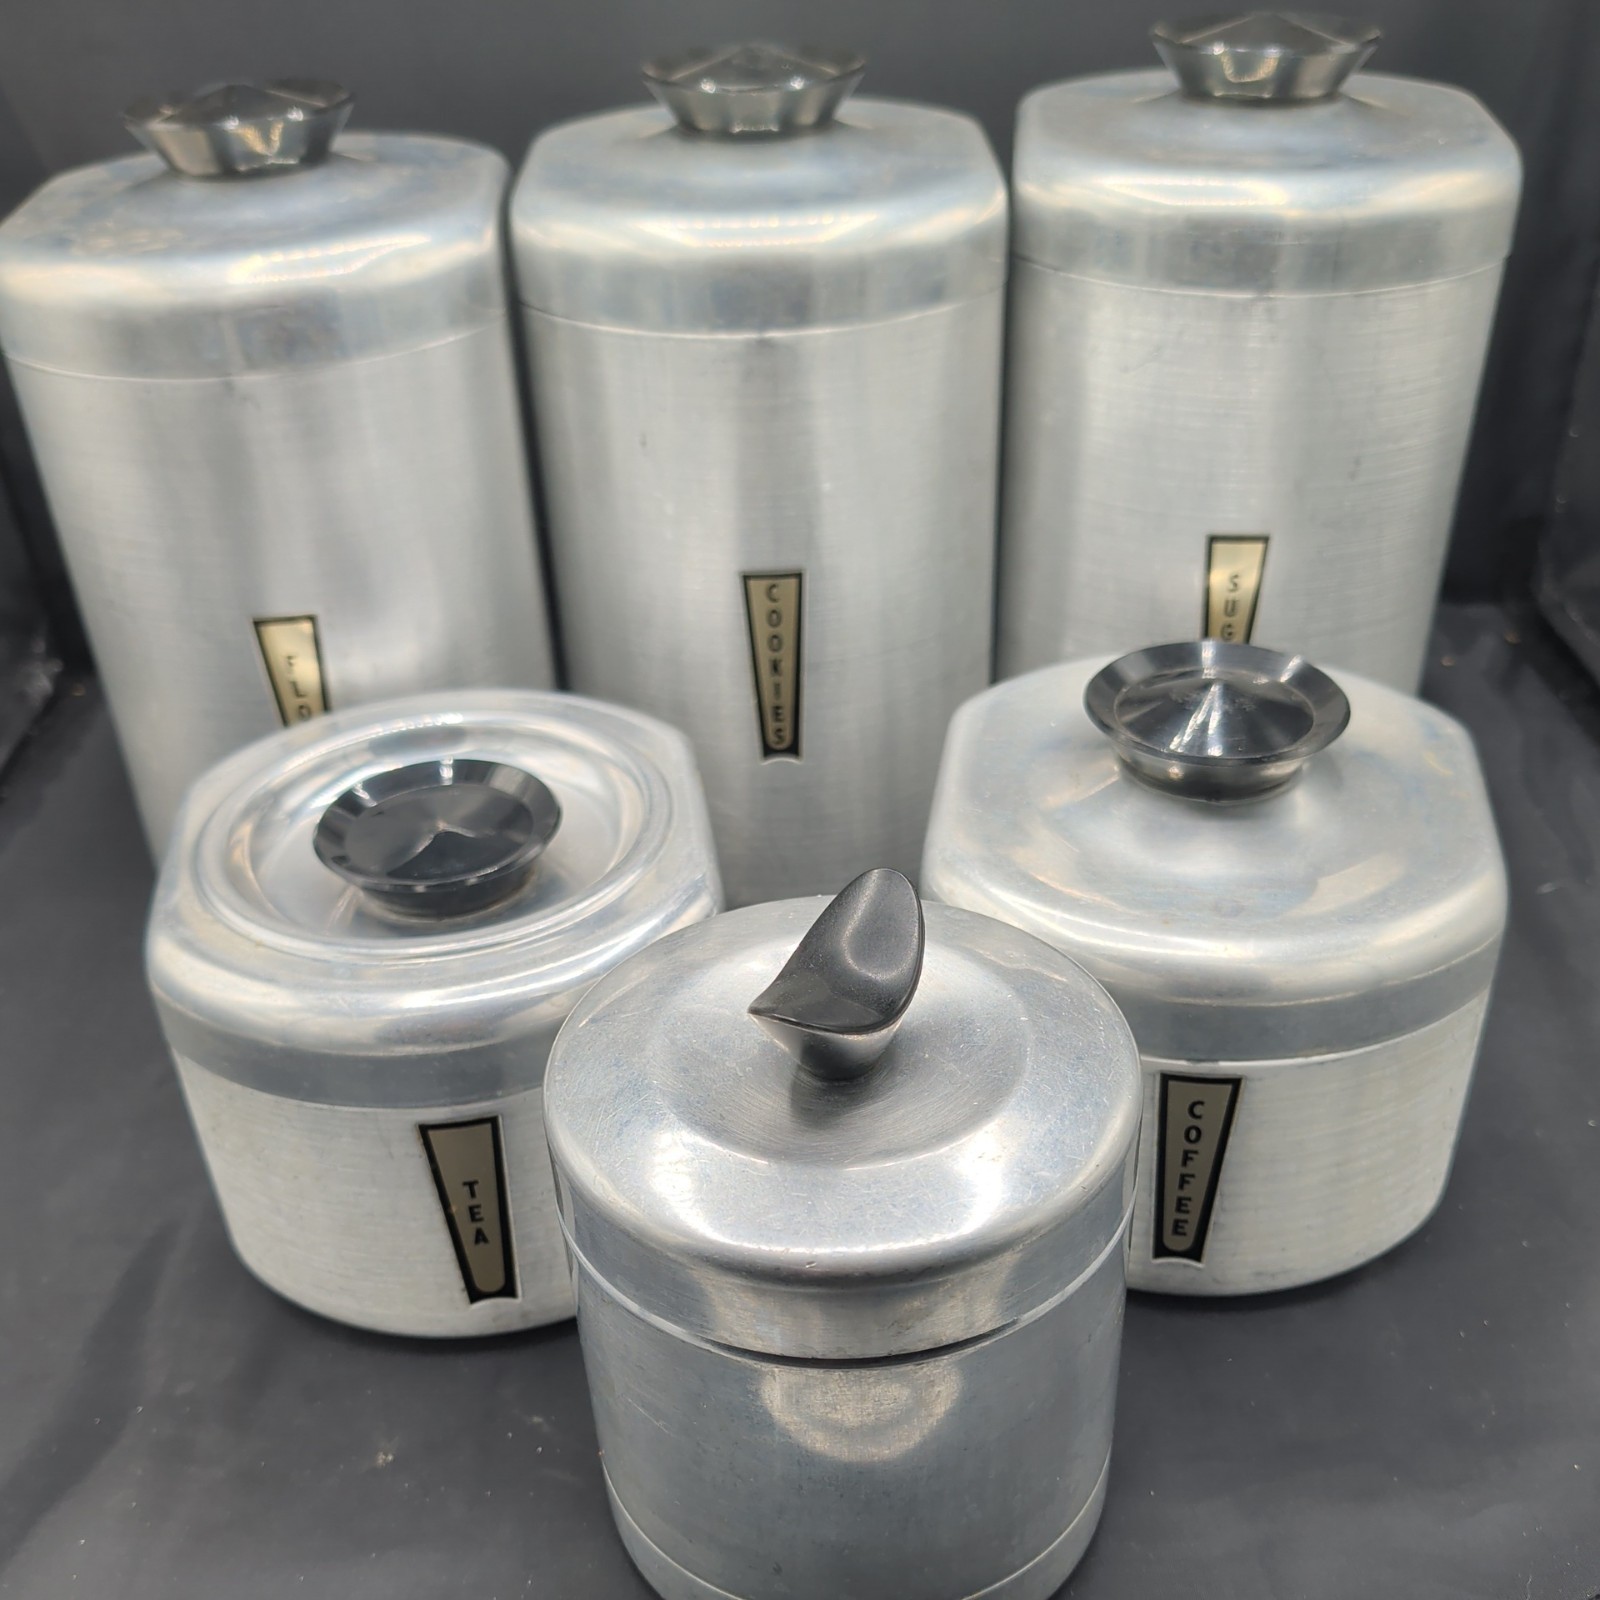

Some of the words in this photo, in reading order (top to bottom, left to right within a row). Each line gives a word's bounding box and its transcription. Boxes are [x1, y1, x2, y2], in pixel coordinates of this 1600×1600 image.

[766, 583, 784, 745] COOKIES
[462, 1179, 490, 1246] TEA
[1170, 1100, 1205, 1237] COFFEE
